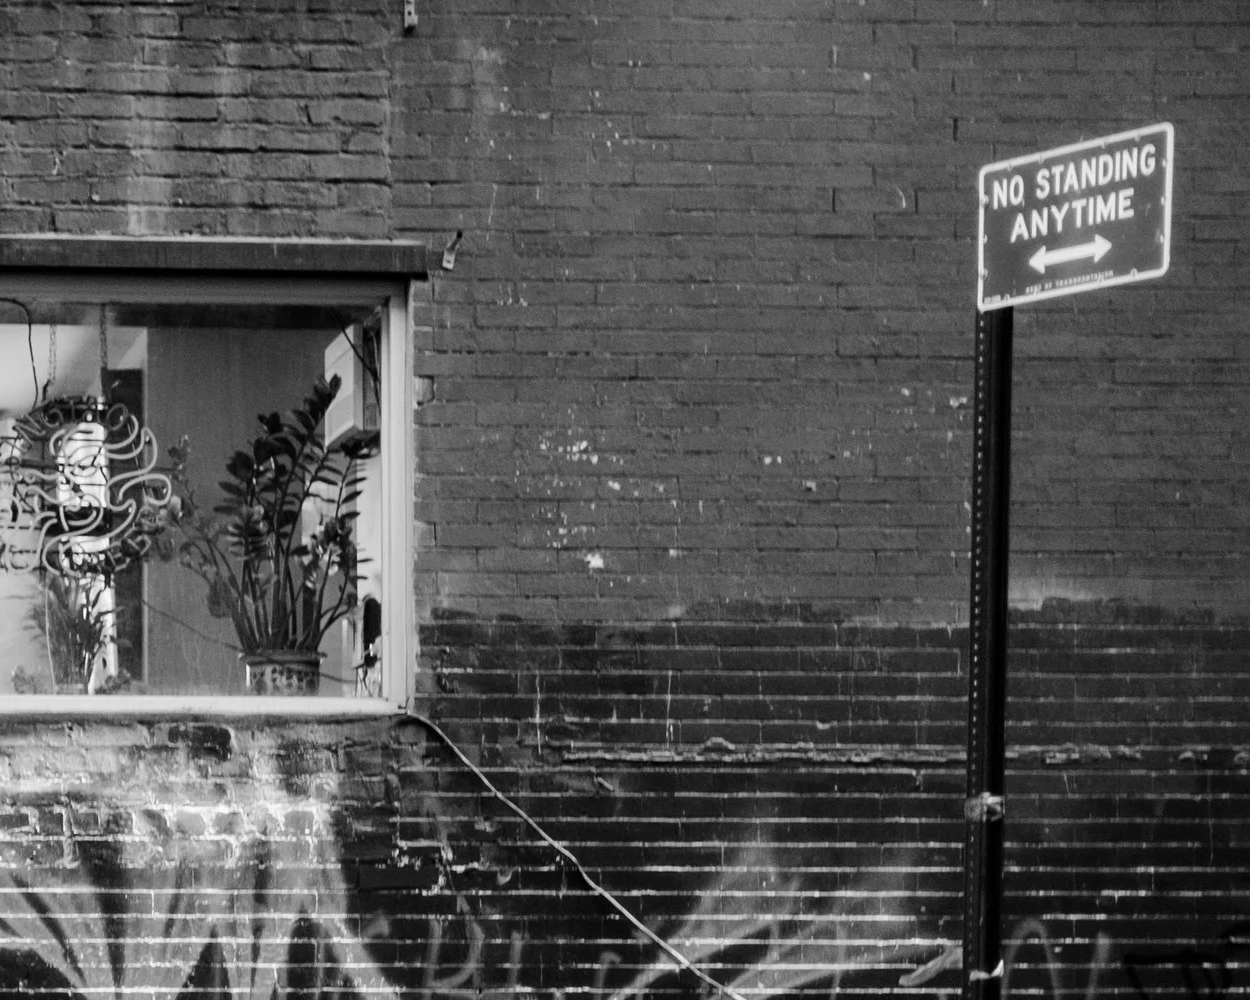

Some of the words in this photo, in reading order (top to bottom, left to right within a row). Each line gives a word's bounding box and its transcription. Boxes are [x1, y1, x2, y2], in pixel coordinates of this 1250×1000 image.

[993, 174, 1025, 210] NO
[1036, 144, 1156, 200] STANDING
[1010, 187, 1135, 244] ANYTIME
